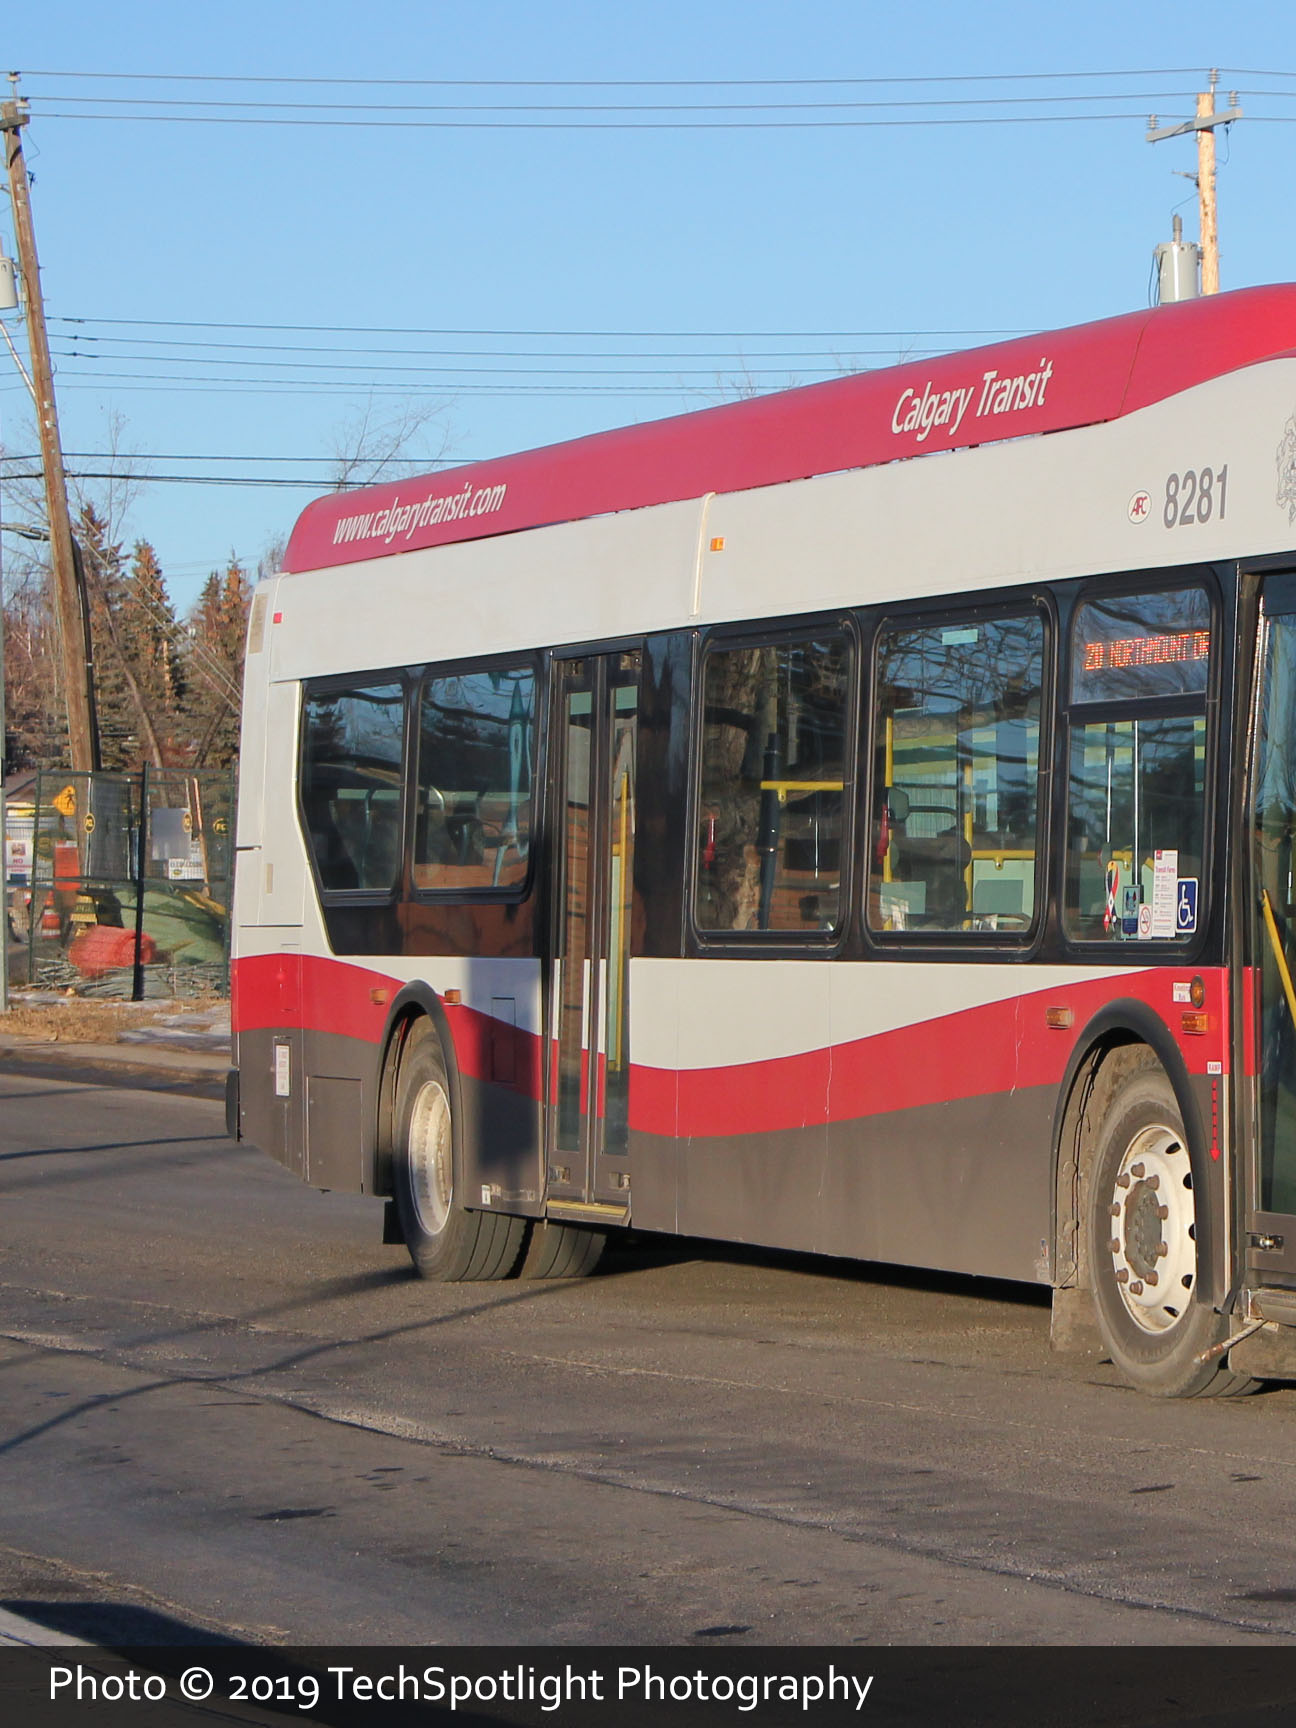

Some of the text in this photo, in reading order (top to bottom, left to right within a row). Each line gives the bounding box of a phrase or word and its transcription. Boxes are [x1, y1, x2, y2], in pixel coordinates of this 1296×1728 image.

[891, 357, 1053, 442] Calgary Transit
[333, 482, 507, 545] www.calgarytransit.com
[1163, 464, 1228, 529] 8281
